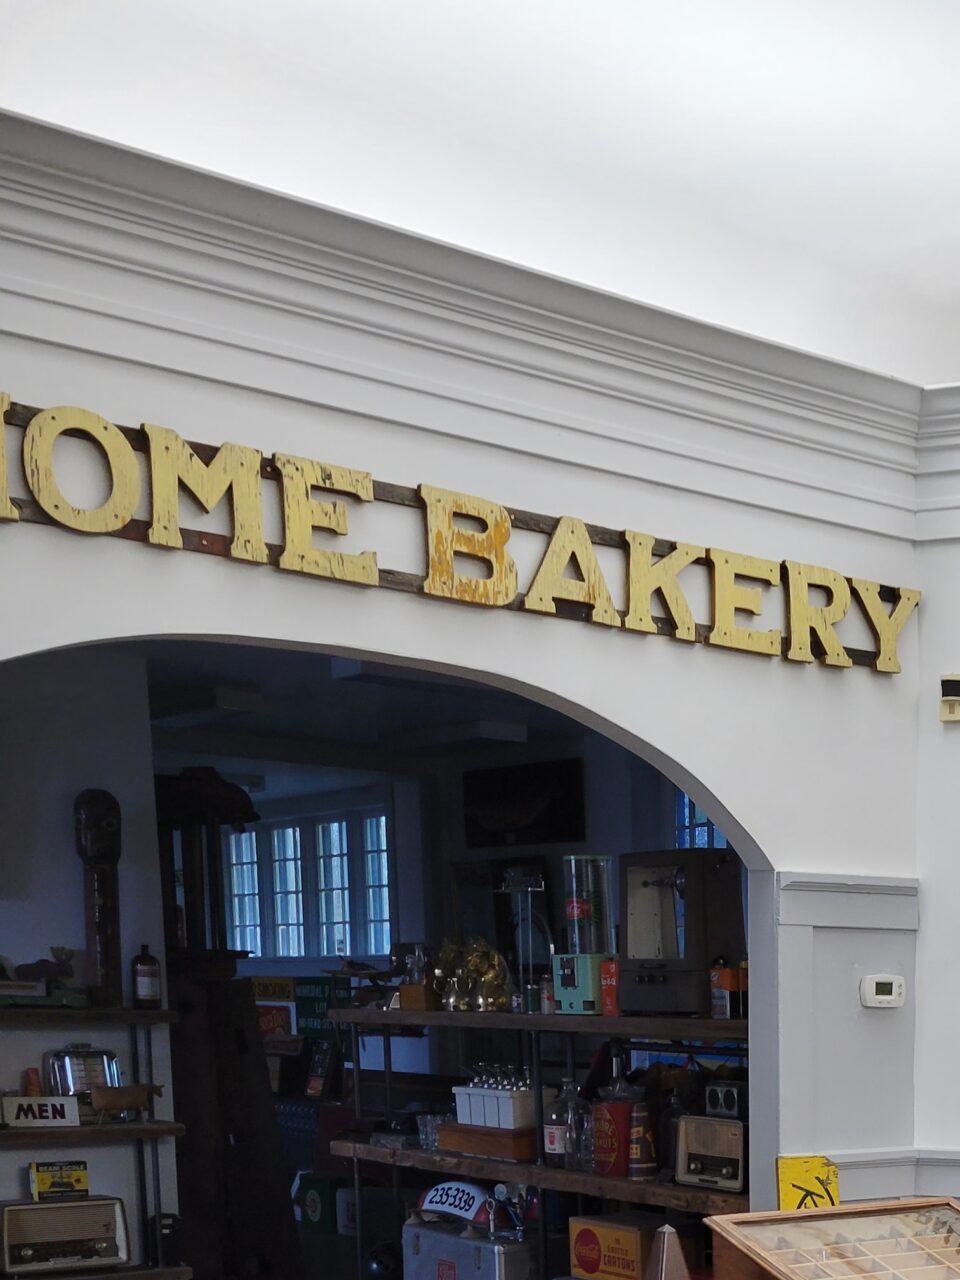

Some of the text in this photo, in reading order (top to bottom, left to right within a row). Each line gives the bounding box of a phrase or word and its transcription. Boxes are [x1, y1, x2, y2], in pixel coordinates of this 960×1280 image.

[0, 390, 922, 674] OME BAKERY
[15, 1103, 66, 1120] MEN
